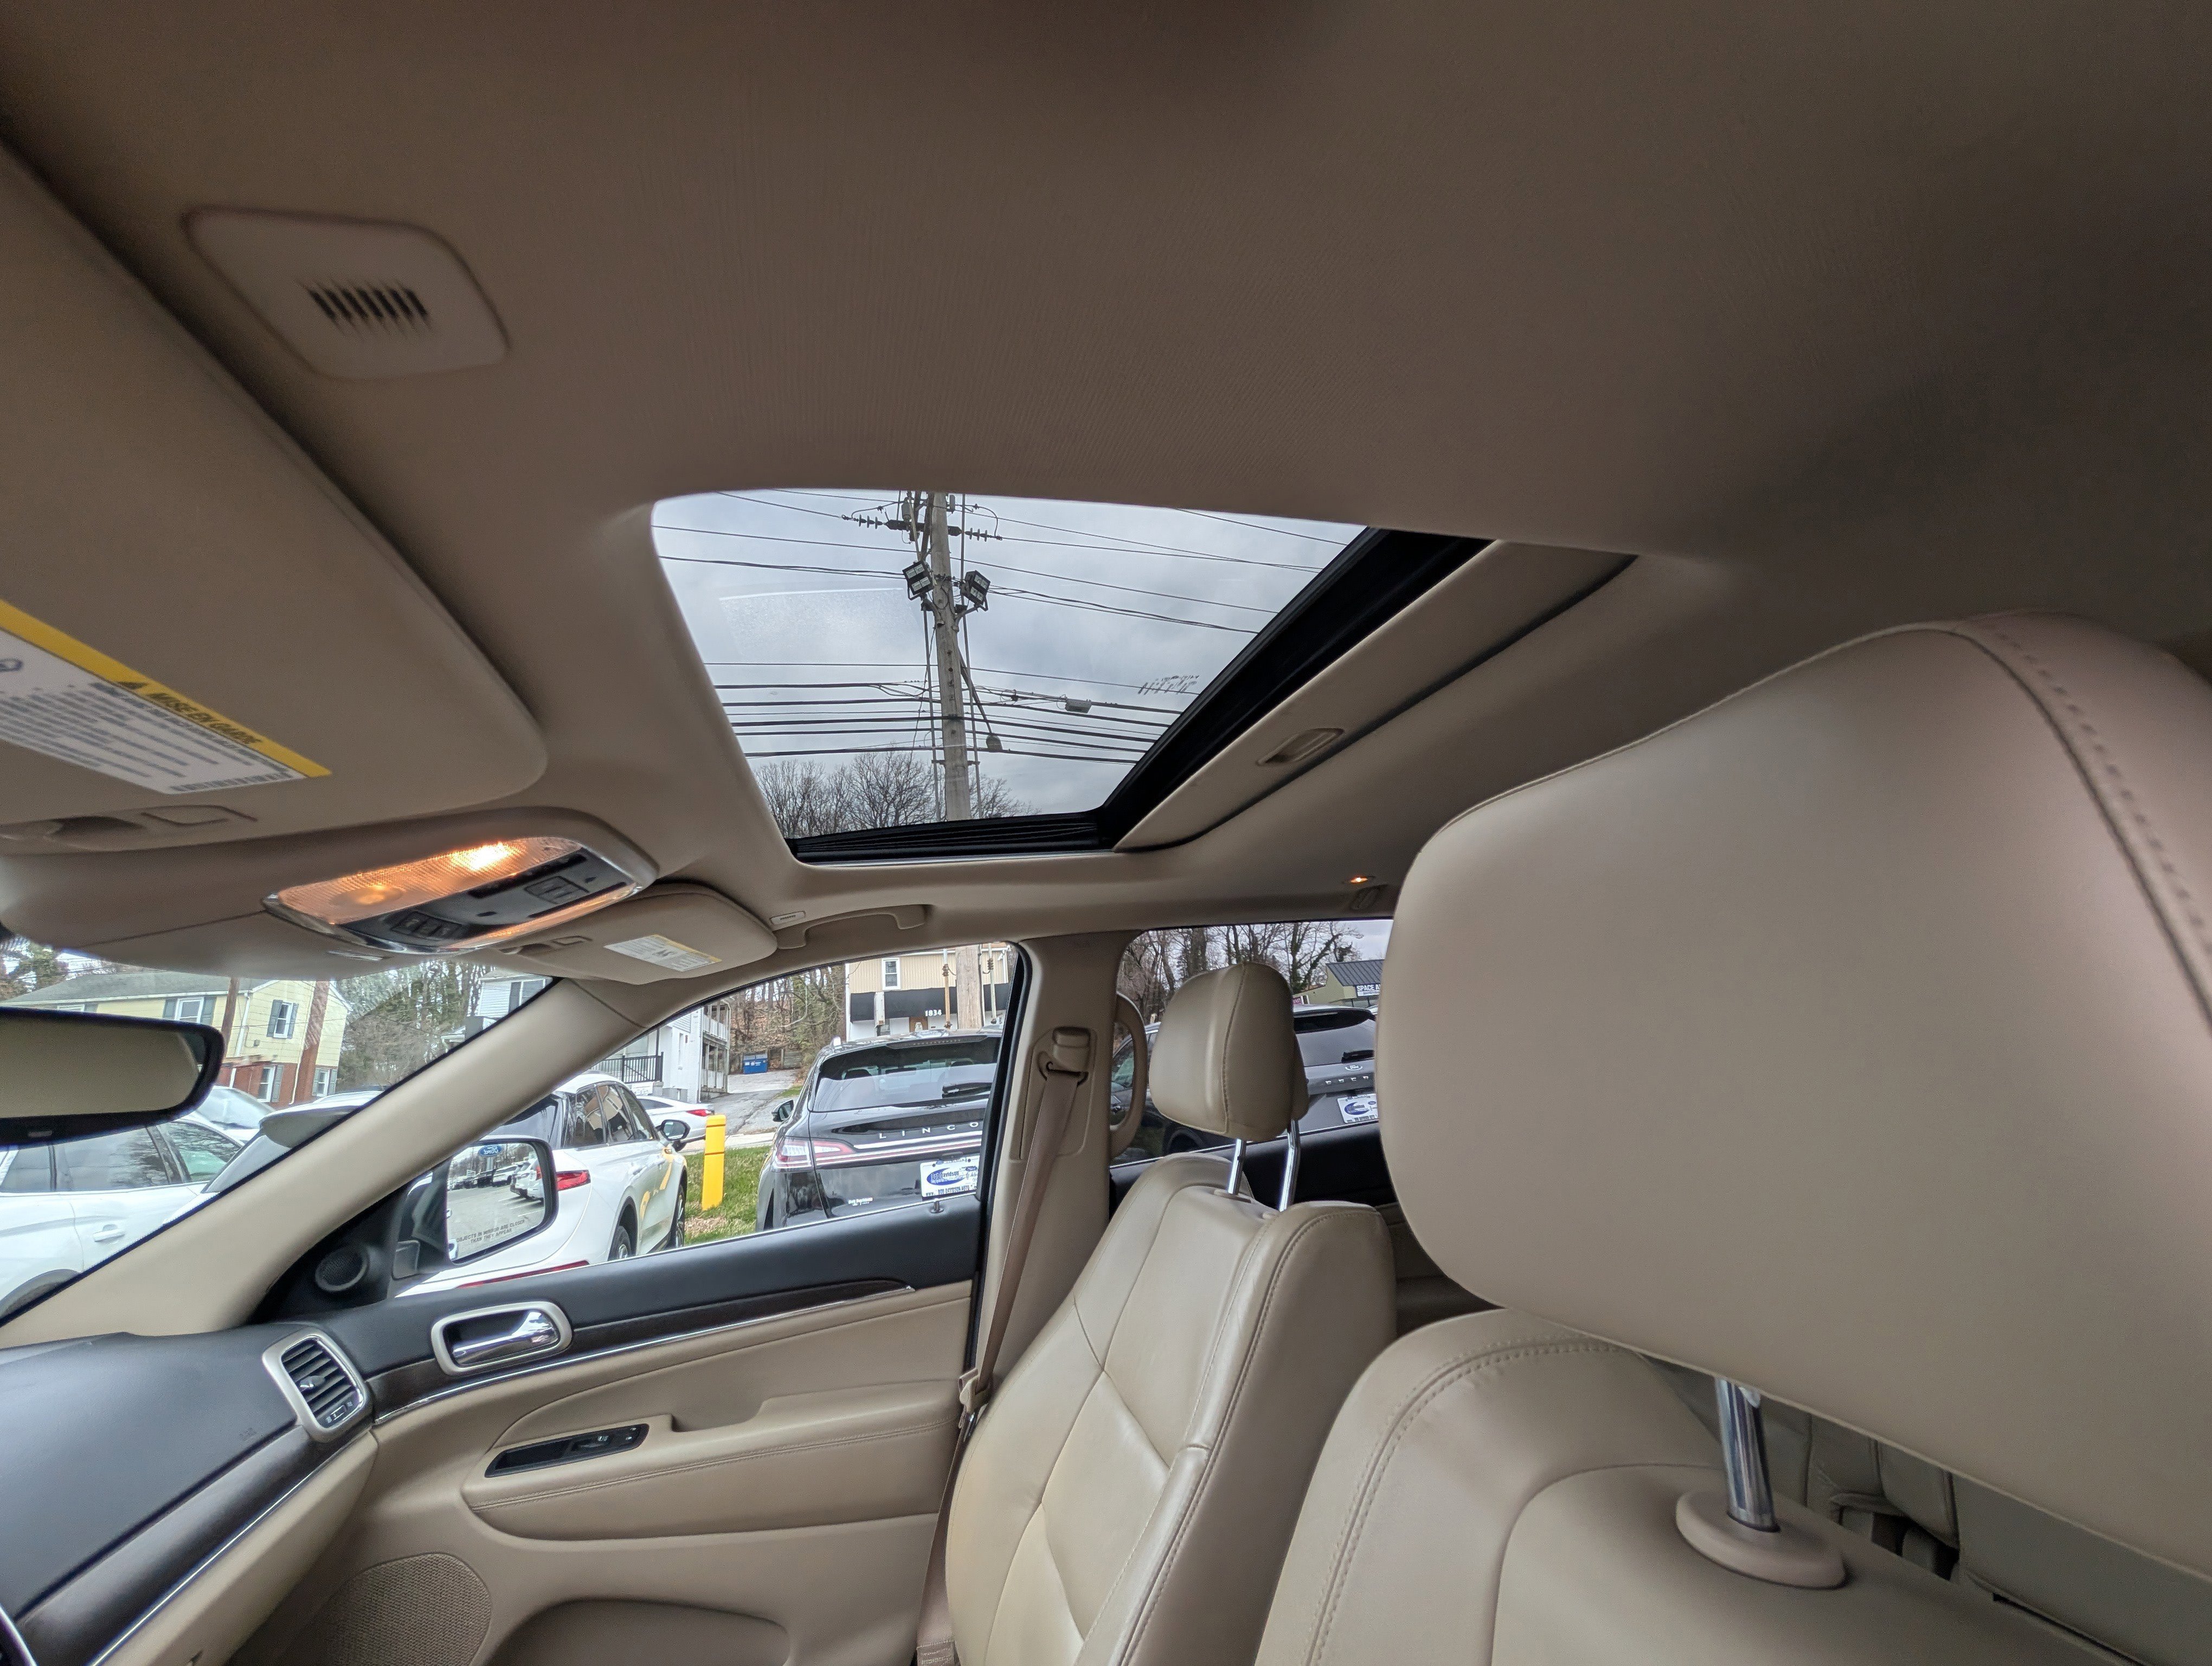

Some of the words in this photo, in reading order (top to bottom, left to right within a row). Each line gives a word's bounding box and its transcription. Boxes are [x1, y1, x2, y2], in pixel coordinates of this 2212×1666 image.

[456, 1233, 477, 1242] OBJECTS
[510, 1219, 525, 1227] CLOSER
[496, 1228, 512, 1236] APPEAR
